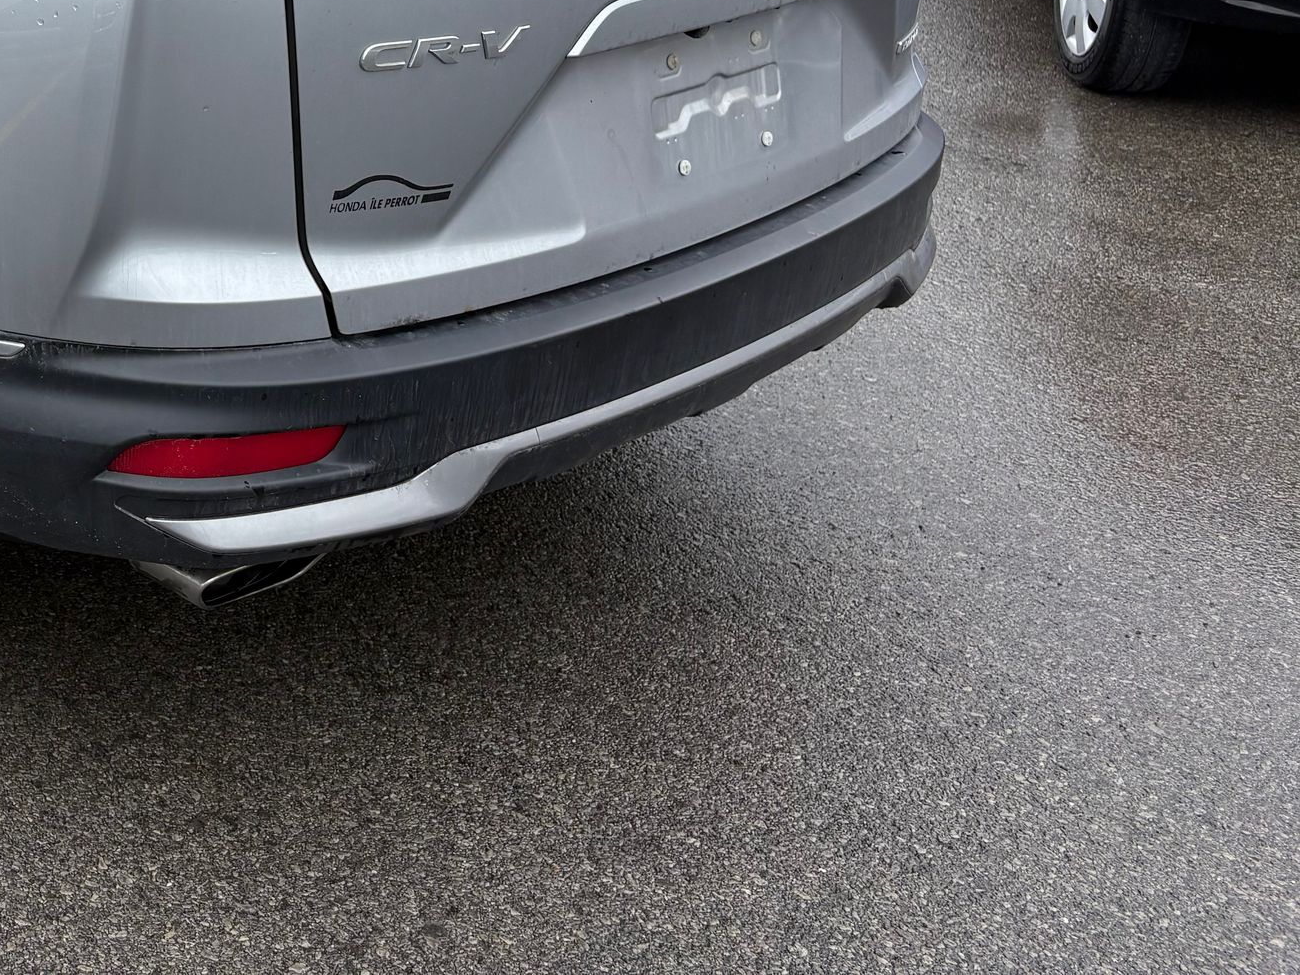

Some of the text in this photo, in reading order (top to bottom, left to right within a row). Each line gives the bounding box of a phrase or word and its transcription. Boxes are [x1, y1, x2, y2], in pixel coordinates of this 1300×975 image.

[359, 25, 531, 73] CR-V
[329, 195, 421, 214] HONDA ÎLE PERROT
